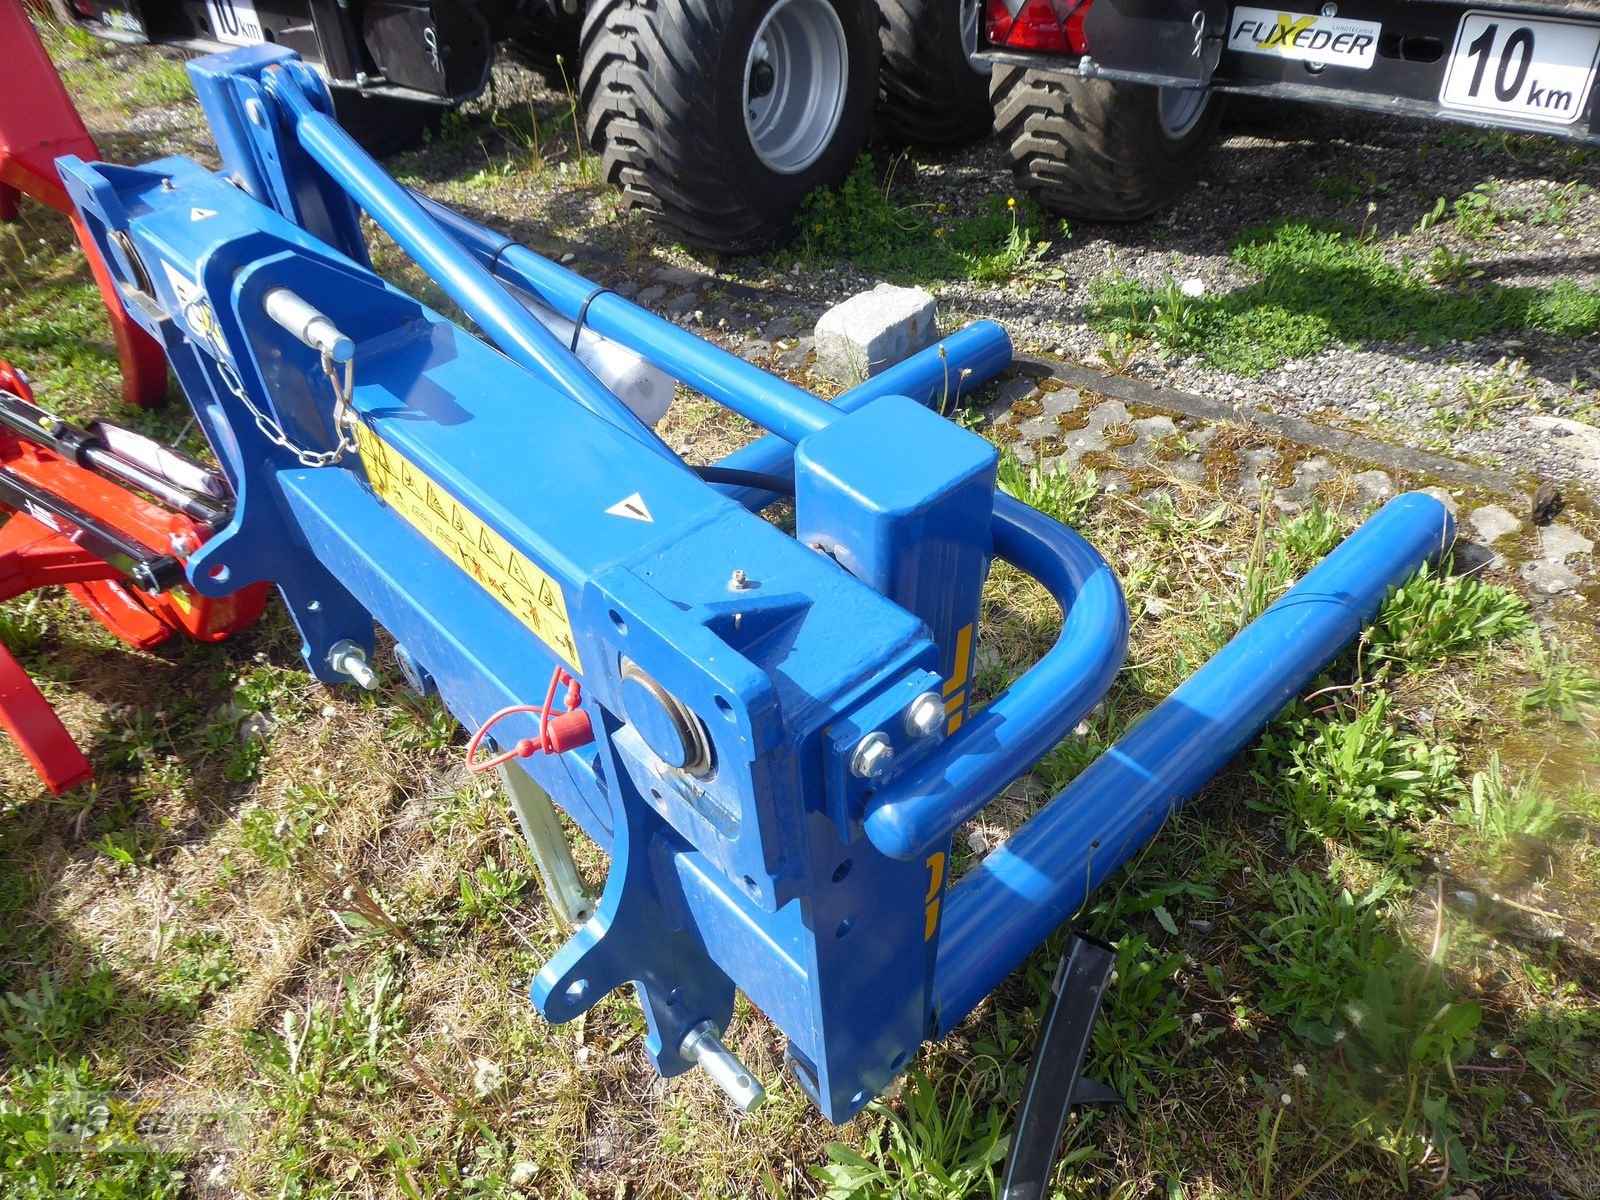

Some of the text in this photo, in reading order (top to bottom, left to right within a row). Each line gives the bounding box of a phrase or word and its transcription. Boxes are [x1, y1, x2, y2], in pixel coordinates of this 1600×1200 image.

[238, 16, 261, 40] km
[1467, 23, 1574, 112] 10 km
